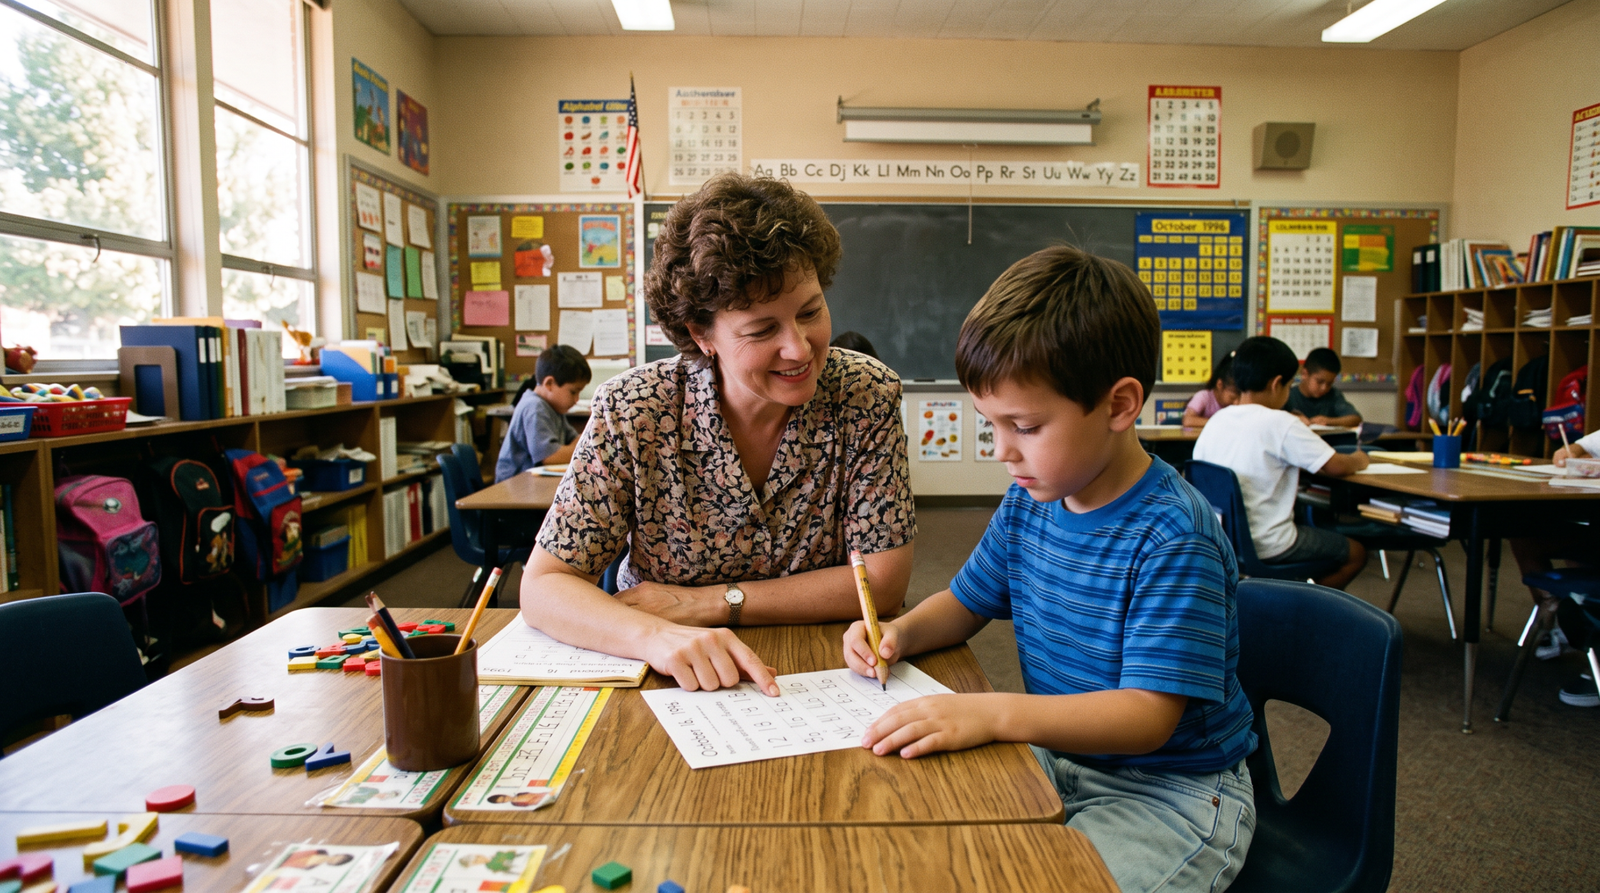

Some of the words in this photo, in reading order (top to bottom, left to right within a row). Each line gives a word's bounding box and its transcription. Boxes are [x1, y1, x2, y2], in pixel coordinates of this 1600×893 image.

[1155, 222, 1197, 231] October
[1203, 222, 1226, 231] 1996
[691, 729, 718, 757] October
